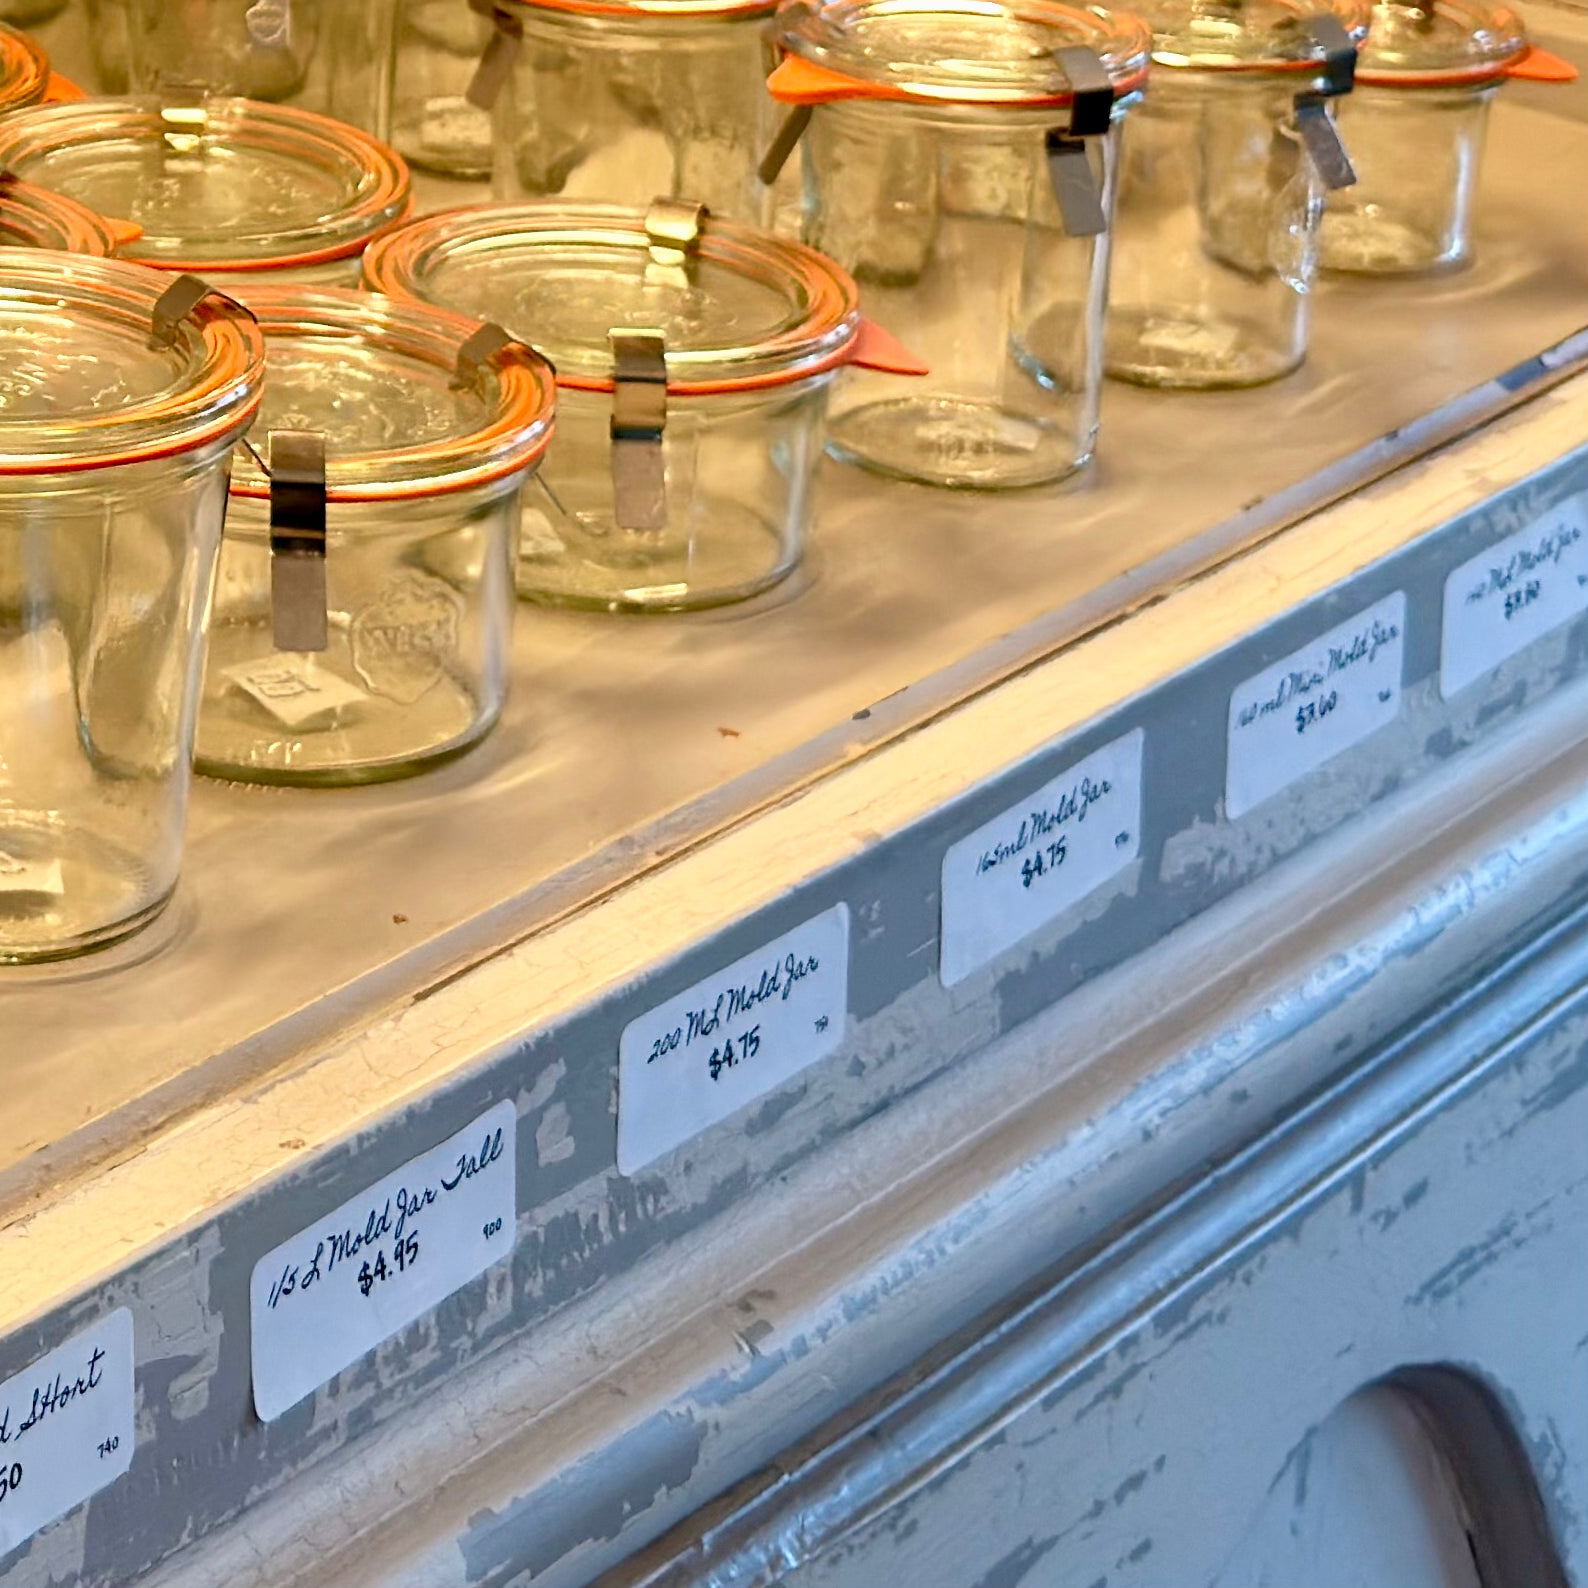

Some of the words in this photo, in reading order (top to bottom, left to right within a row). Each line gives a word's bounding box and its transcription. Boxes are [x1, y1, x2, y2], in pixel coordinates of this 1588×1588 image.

[1030, 785, 1078, 843] Mold
[1078, 777, 1112, 822] Jar
[1021, 835, 1068, 888] $4.75
[647, 1027, 681, 1064] 200
[726, 961, 782, 1022] Mold
[781, 952, 819, 1000] Jar
[708, 1024, 761, 1081] $4.75
[267, 1264, 300, 1309] 1/5
[301, 1242, 324, 1290] L
[327, 1198, 392, 1271] Mold
[394, 1187, 437, 1239] Jar
[440, 1127, 505, 1191] Tall
[357, 1230, 419, 1297] $4.95
